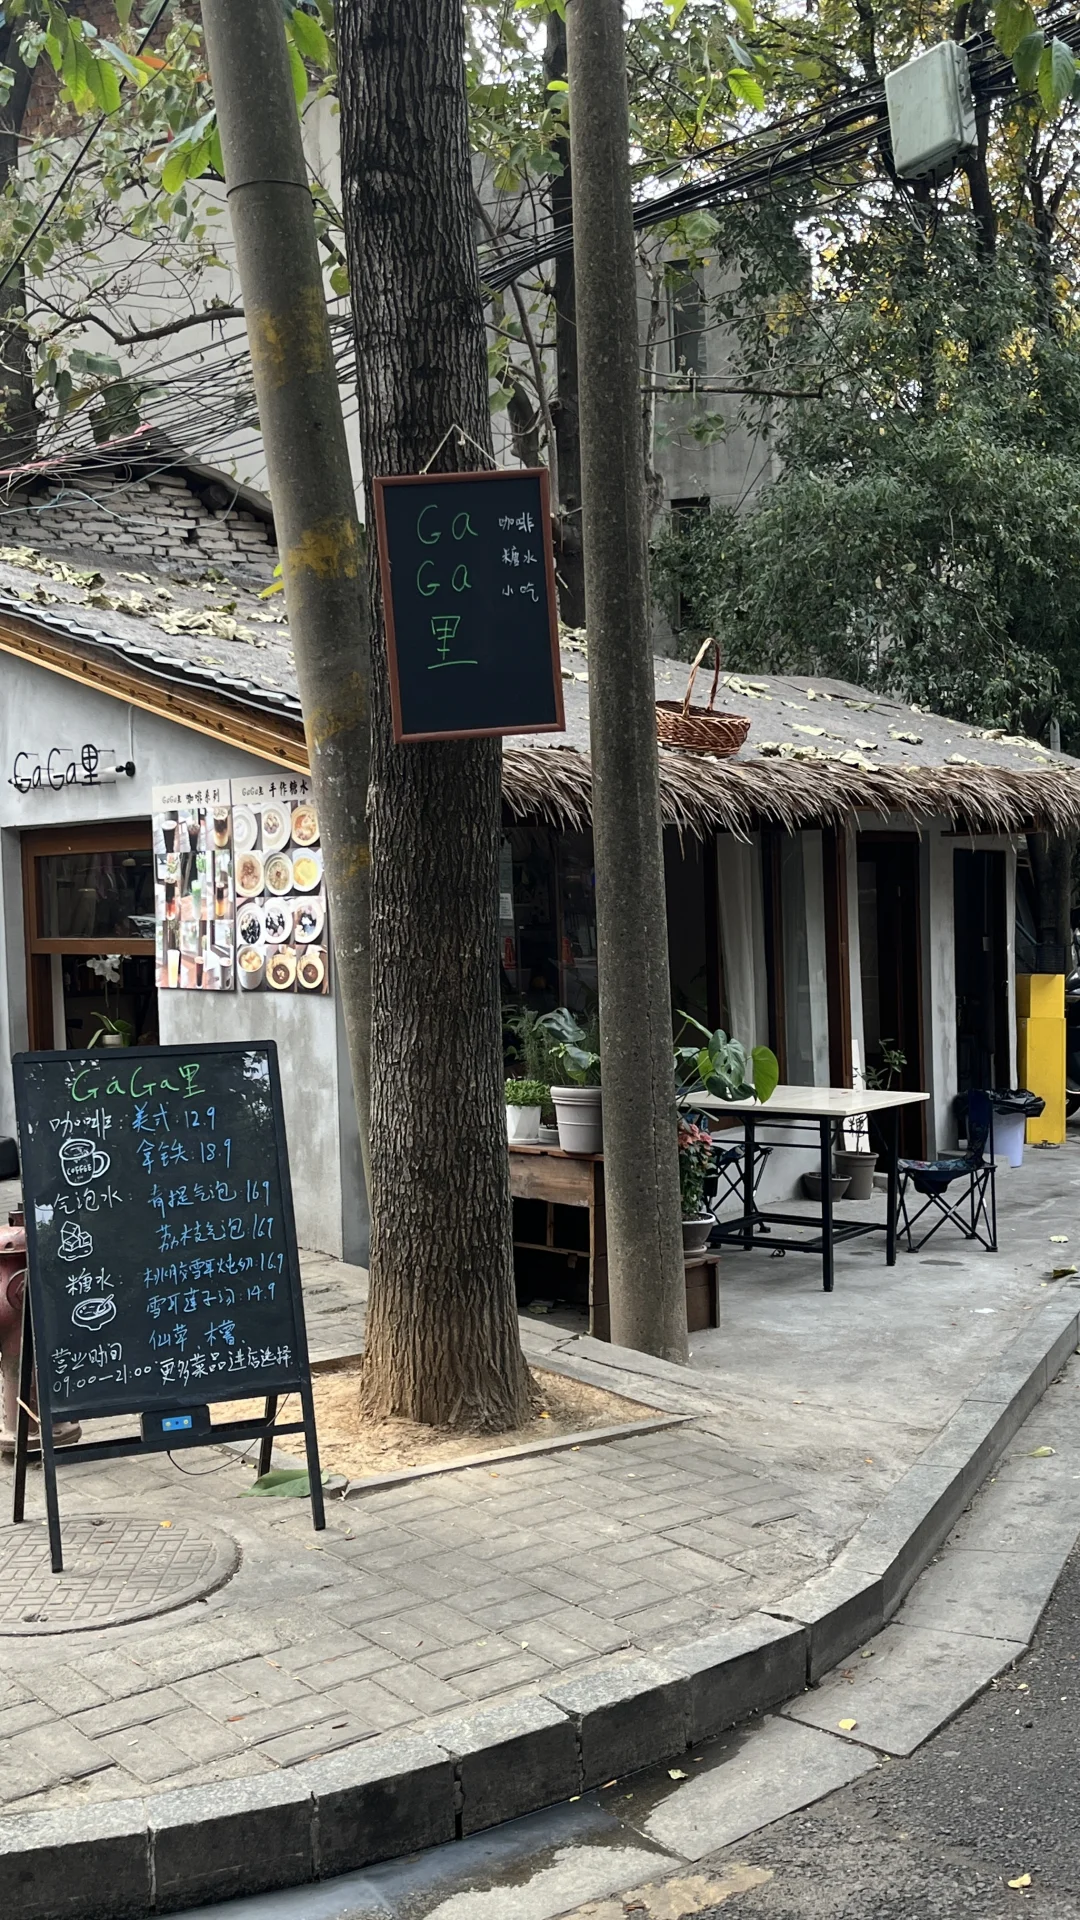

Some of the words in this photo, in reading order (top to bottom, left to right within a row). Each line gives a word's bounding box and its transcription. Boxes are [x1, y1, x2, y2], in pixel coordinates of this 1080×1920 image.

[417, 505, 478, 544] Ga
[499, 512, 535, 533] 咖啡
[502, 545, 537, 567] 糖水
[417, 561, 471, 596] Ga
[502, 582, 539, 602] 小吃
[428, 616, 478, 669] 里
[13, 744, 99, 794] GaGa里
[186, 788, 220, 804] 咖啡系列
[269, 779, 309, 798] 手作糖水
[72, 1063, 206, 1102] GaGa里
[67, 1163, 92, 1175] COFFEE
[51, 1342, 122, 1374] 营业时间
